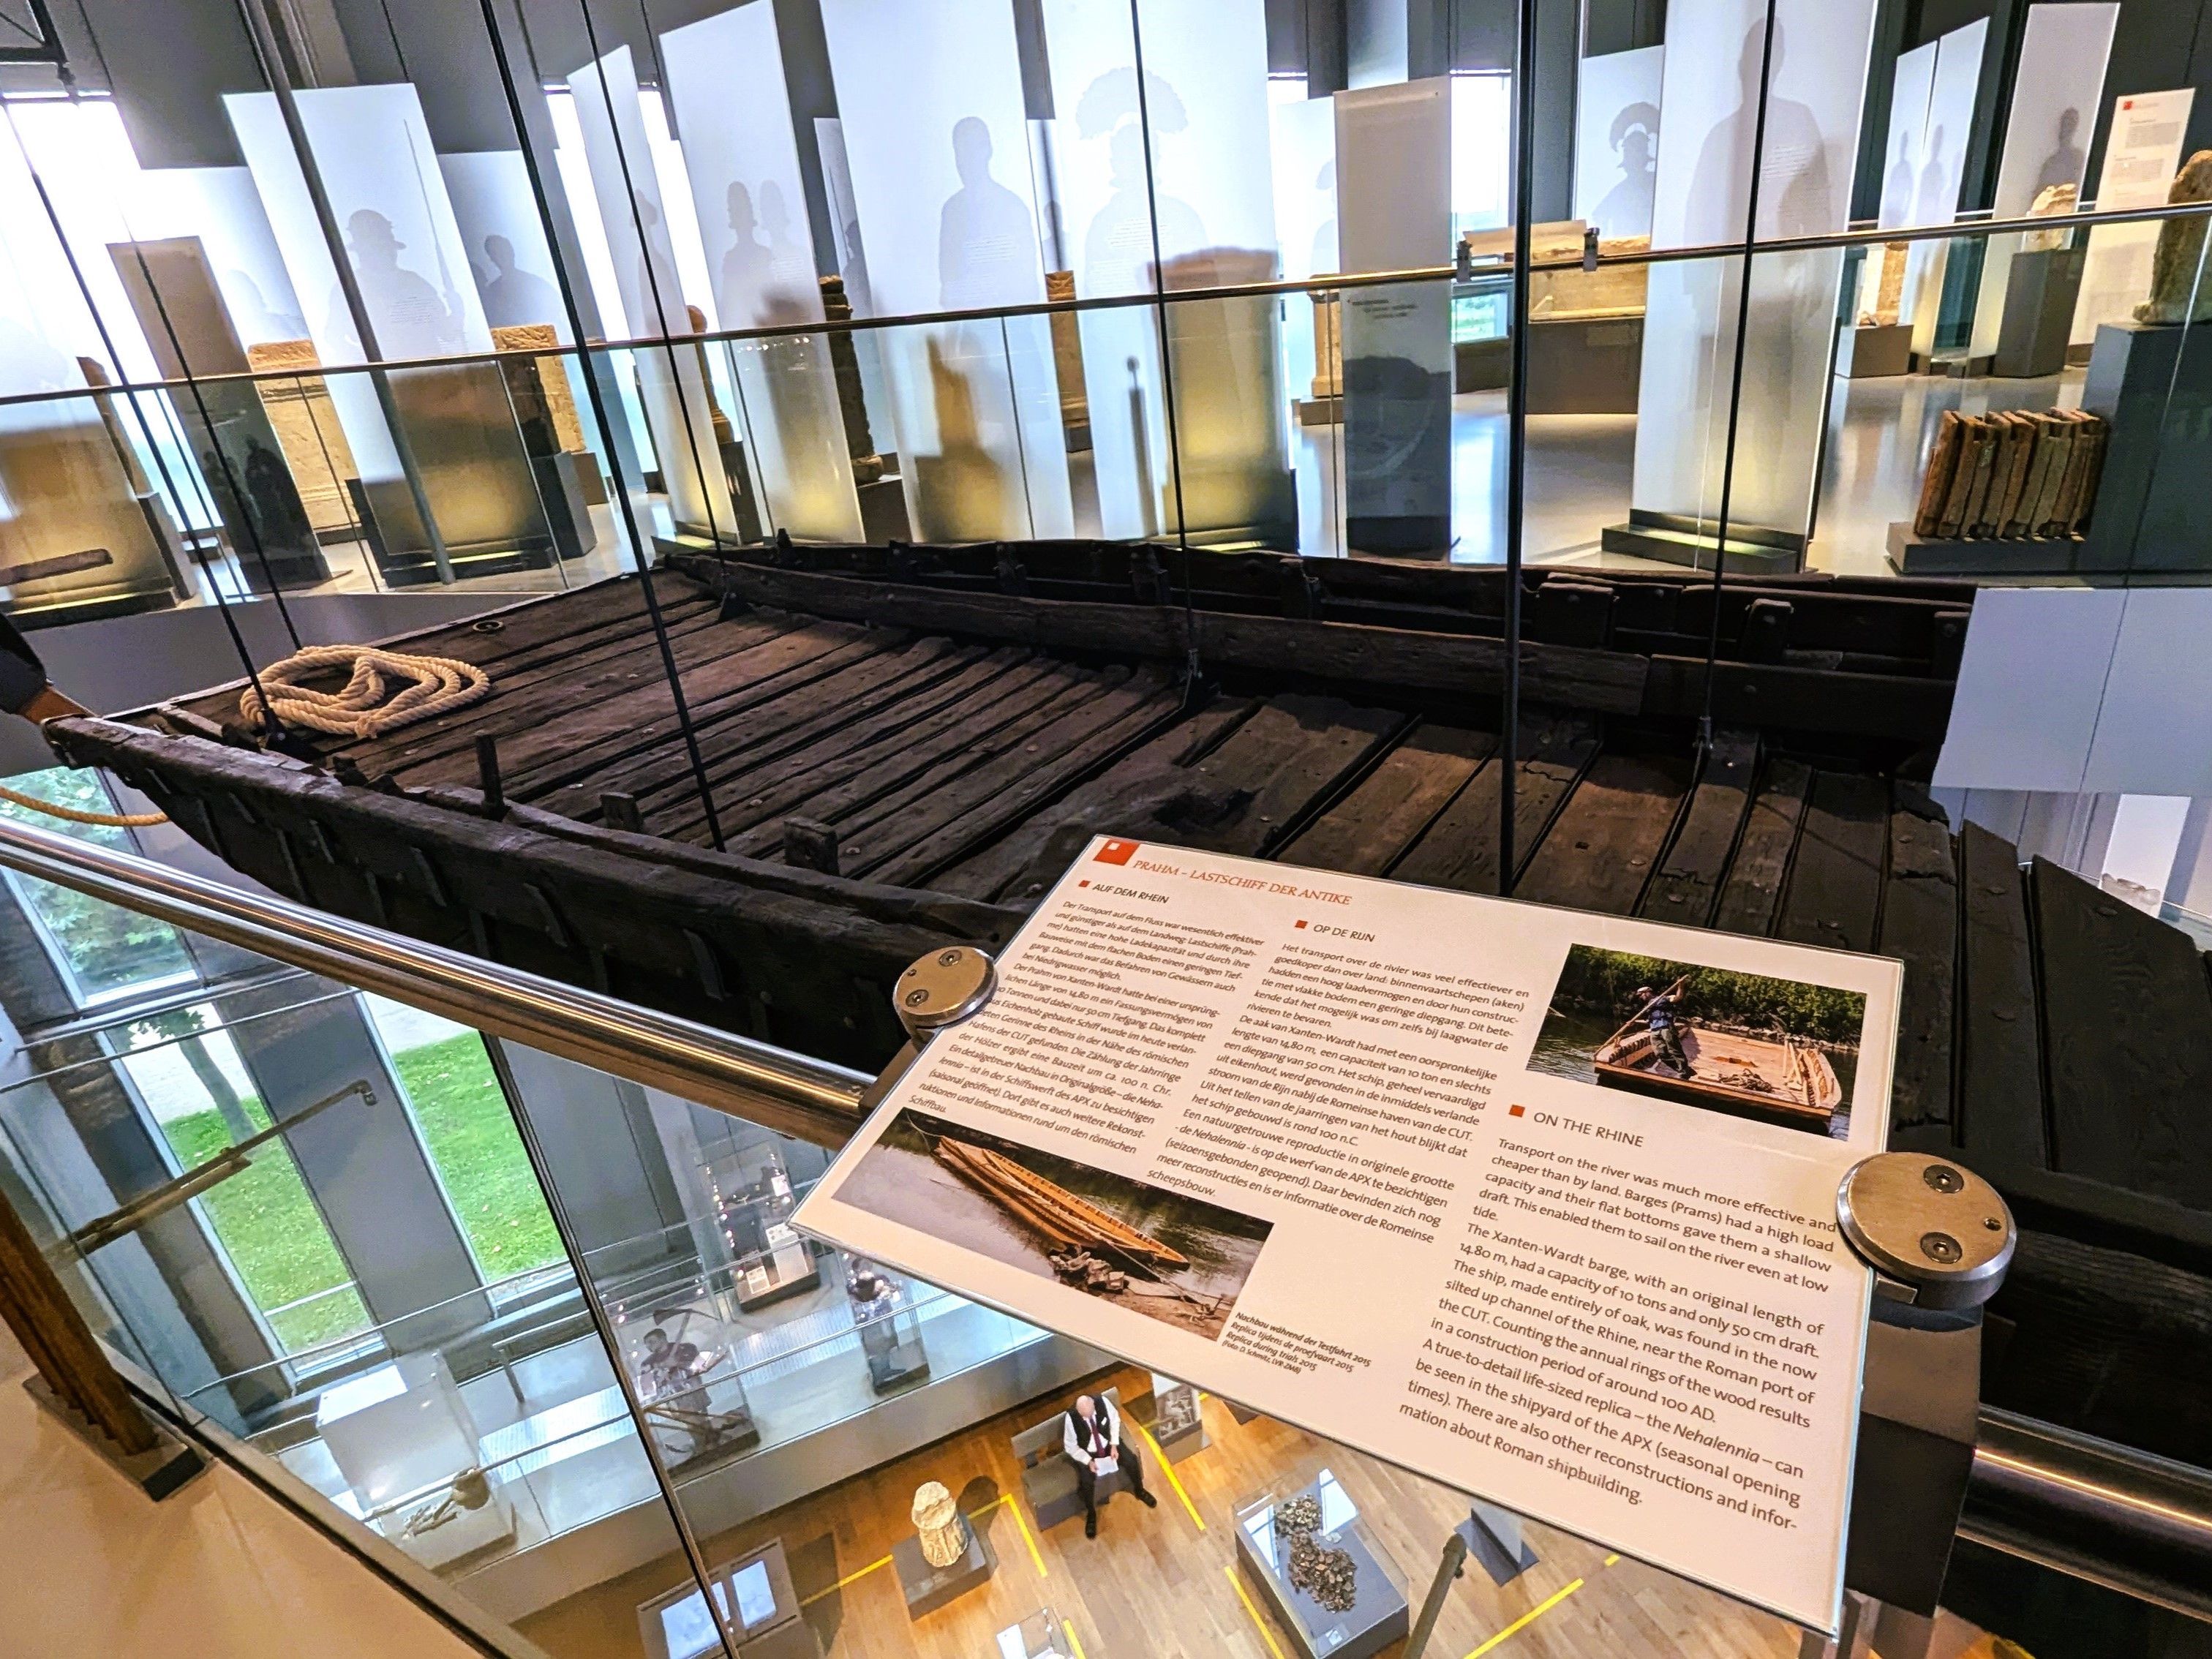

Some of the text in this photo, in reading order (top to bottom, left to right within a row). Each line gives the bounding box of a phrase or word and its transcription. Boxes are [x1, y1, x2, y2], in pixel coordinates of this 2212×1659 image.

[1091, 884, 1170, 904] AUF DEM RHEIN
[1132, 859, 1180, 876] PRAHM
[1189, 870, 1268, 890] LASTSCHIFF
[1268, 883, 1298, 897] DER
[1297, 889, 1353, 906] ANTIKE
[1313, 924, 1376, 943] OP DE RIJN
[1274, 956, 1324, 970] goedkoper
[1323, 964, 1342, 974] dan
[1342, 970, 1364, 979] over
[1389, 977, 1490, 1004] binnenvaartschepen
[1491, 997, 1525, 1012] (aken)
[1281, 943, 1530, 998] Het transport over de rivier was veel effectiever en
[918, 1083, 1137, 1154] ruktionen und Informationen rund um den römischen
[928, 1068, 966, 1085] (saisonal
[1001, 1090, 1023, 1102] Dort
[1019, 1097, 1040, 1108] gibt
[1039, 1102, 1051, 1111] es
[1049, 1105, 1072, 1118] auch
[1072, 1112, 1107, 1128] weitere
[1533, 1112, 1644, 1148] ON THE RHINE
[1146, 1170, 1216, 1197] scheepsbouw.
[1165, 1137, 1442, 1228] (seizoensgebonden geopend). Daar bevinden zich nog
[1182, 1108, 1455, 1191] Een natuurgetrouwe reproductie in originele grootte
[1499, 1137, 1837, 1233] Transport on the river was much more effective and
[1485, 1173, 1832, 1273] capacity and their flat bottoms gave them a shallow
[1491, 1156, 1835, 1252] cheaper than by land. Barges (Prams) had a high load
[1478, 1188, 1829, 1293] draft. This enabled them to sail on the river even at low
[1467, 1222, 1825, 1336] The Xanten-Wardt barge, with an original length of
[1225, 1331, 1318, 1372] Replica during trials 2015
[1230, 1321, 1355, 1373] Replica tijdens de proefvaart 2015
[1235, 1312, 1372, 1367] Nachbau während der Testfahrt 2015
[1454, 1259, 1818, 1381] The ship, made entirely of oak, was found in the now
[1430, 1317, 1716, 1423] in a construction period of around 100 AD.
[1399, 1404, 1642, 1505] mation about Roman shipbuilding.
[1407, 1380, 1797, 1529] times). There are also other reconstructions and infor-
